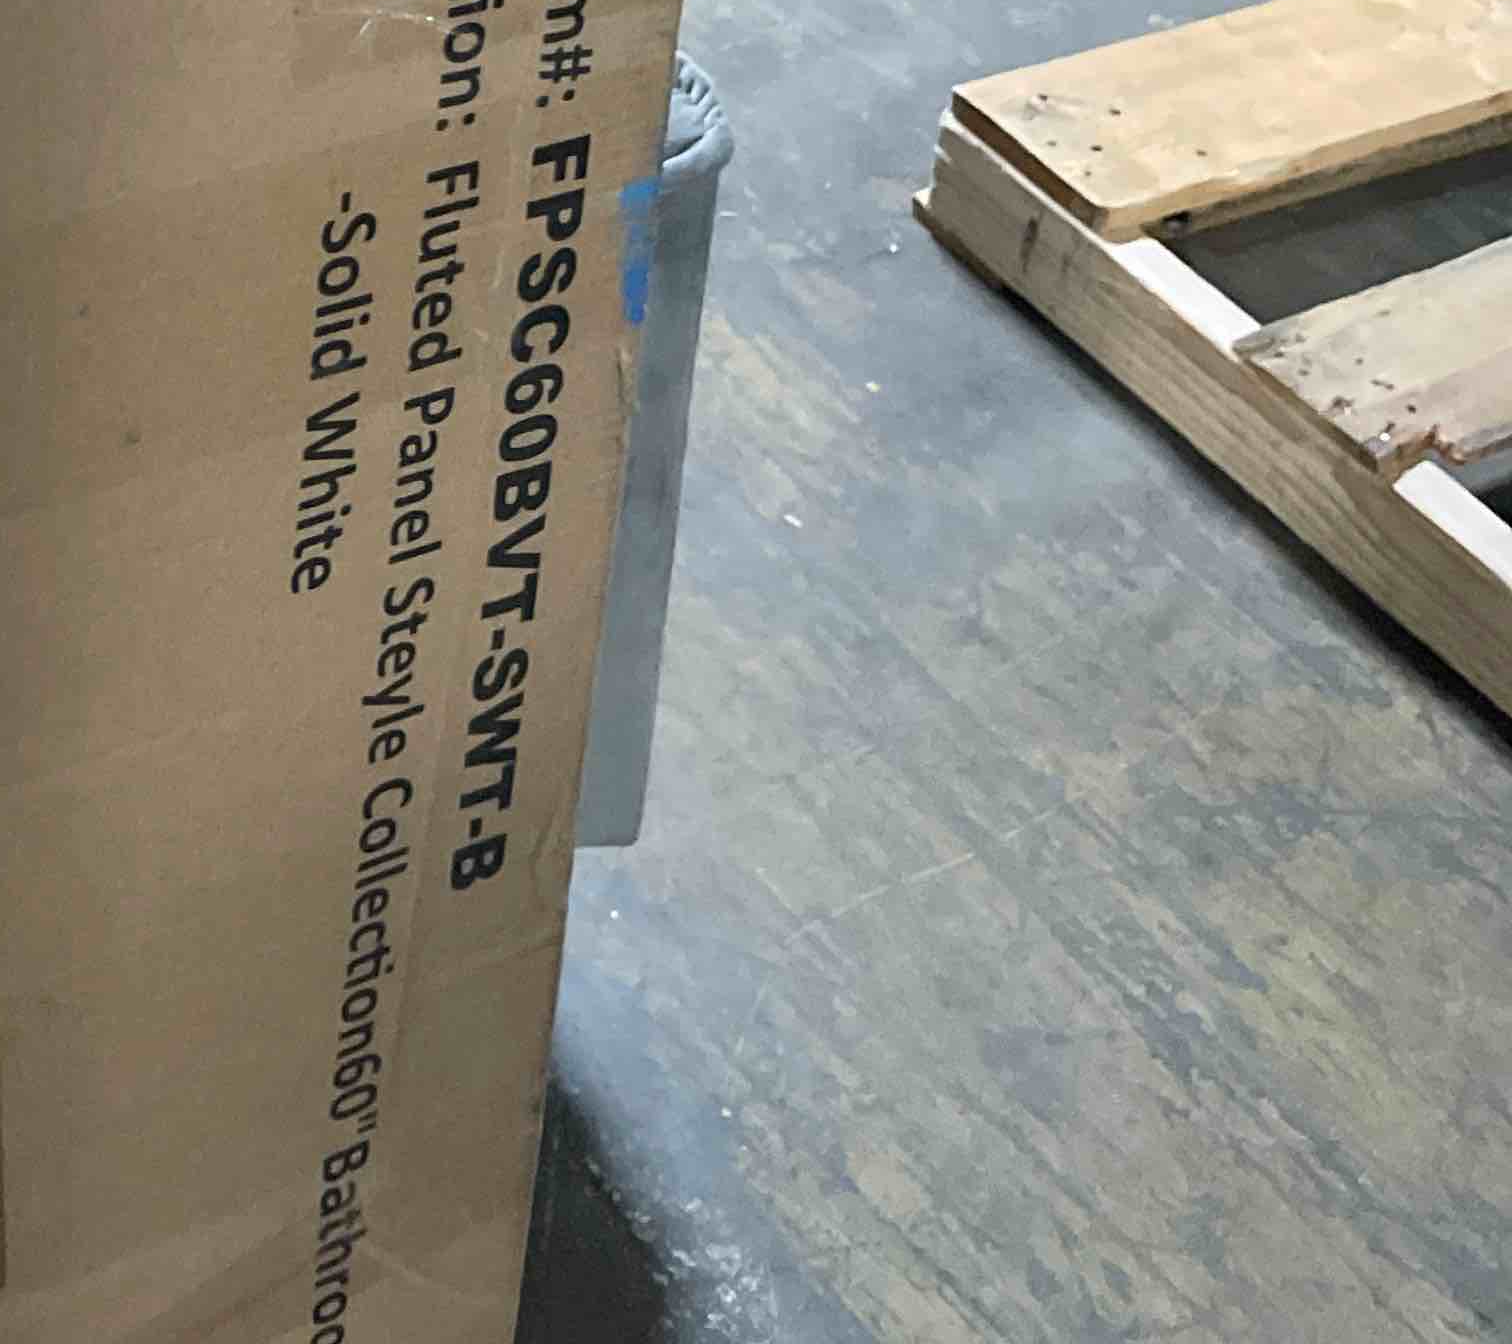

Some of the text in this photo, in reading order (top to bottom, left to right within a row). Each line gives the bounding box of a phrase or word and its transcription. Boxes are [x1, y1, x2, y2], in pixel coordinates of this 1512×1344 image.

[408, 160, 480, 373] Fluted
[290, 192, 377, 594] -Solid White
[388, 386, 456, 566] Panel
[360, 575, 436, 765] Steyle
[329, 775, 414, 1135] Collection60"
